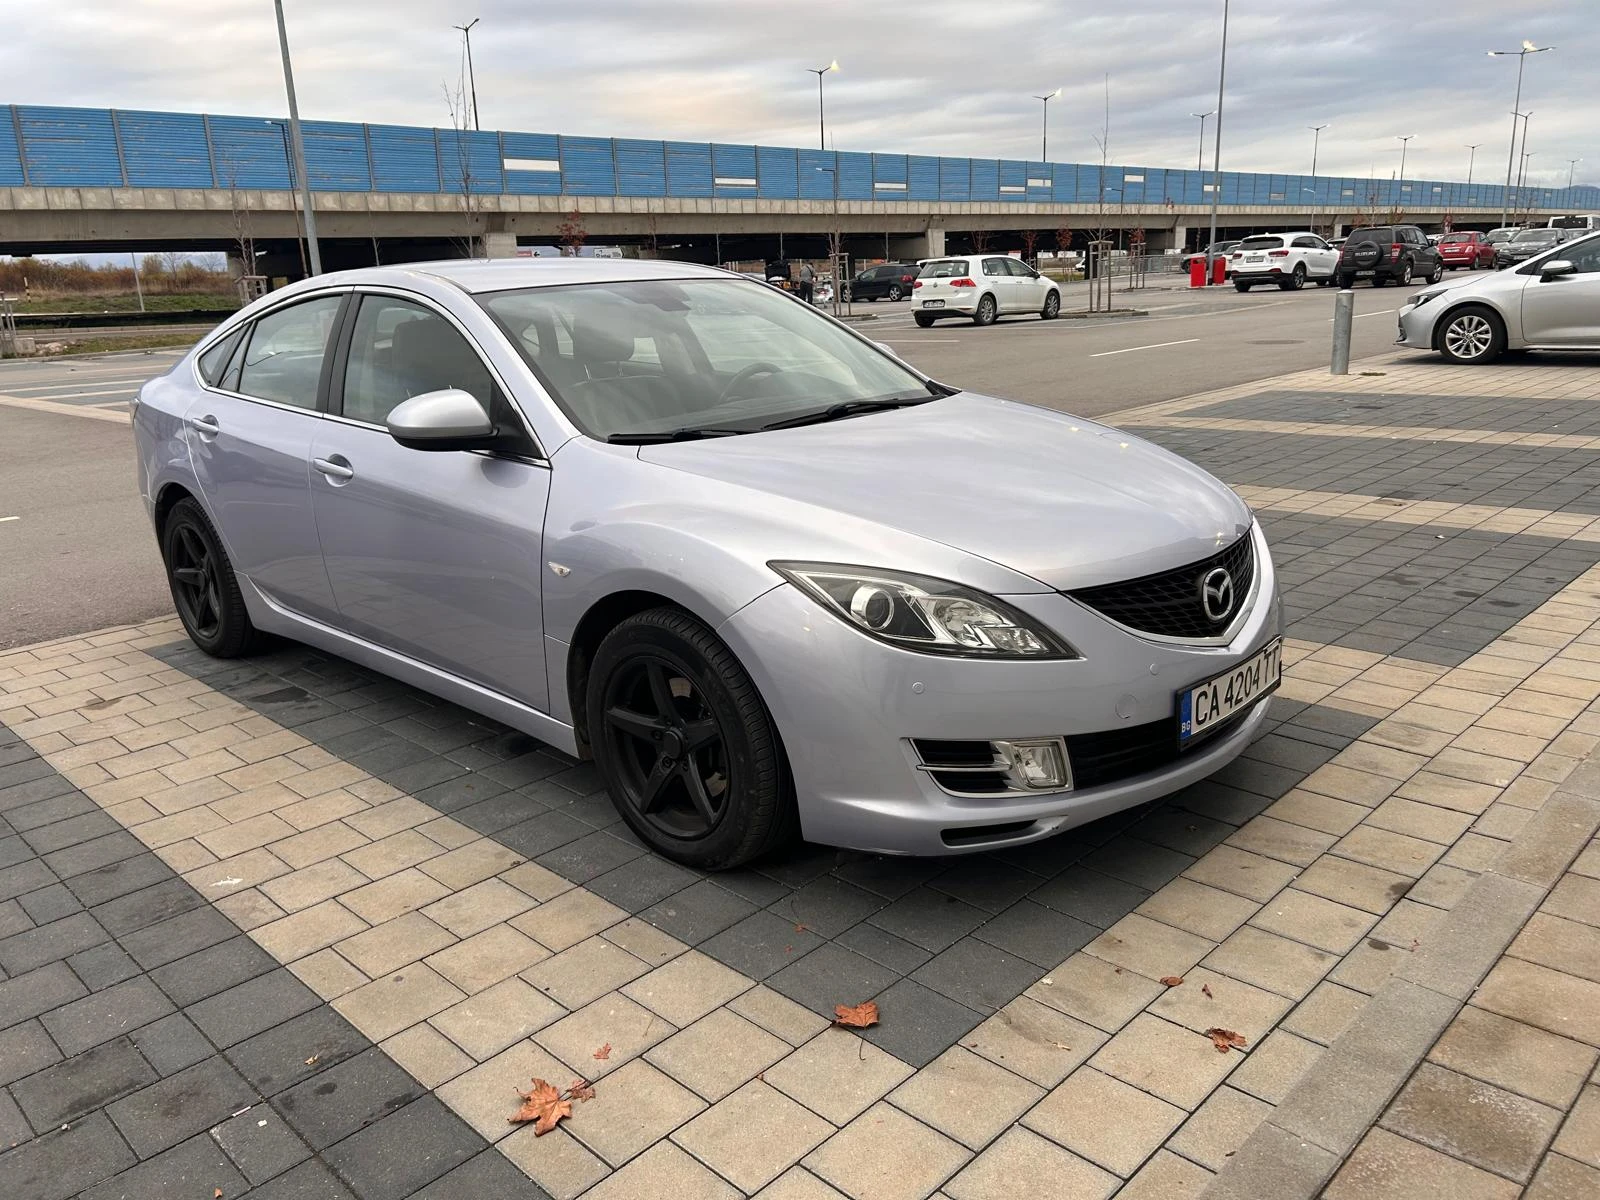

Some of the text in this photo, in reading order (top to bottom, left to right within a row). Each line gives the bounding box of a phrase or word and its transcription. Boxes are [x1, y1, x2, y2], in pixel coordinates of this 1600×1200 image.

[1195, 644, 1279, 726] CA 4204 TT
[1181, 720, 1191, 733] BG
